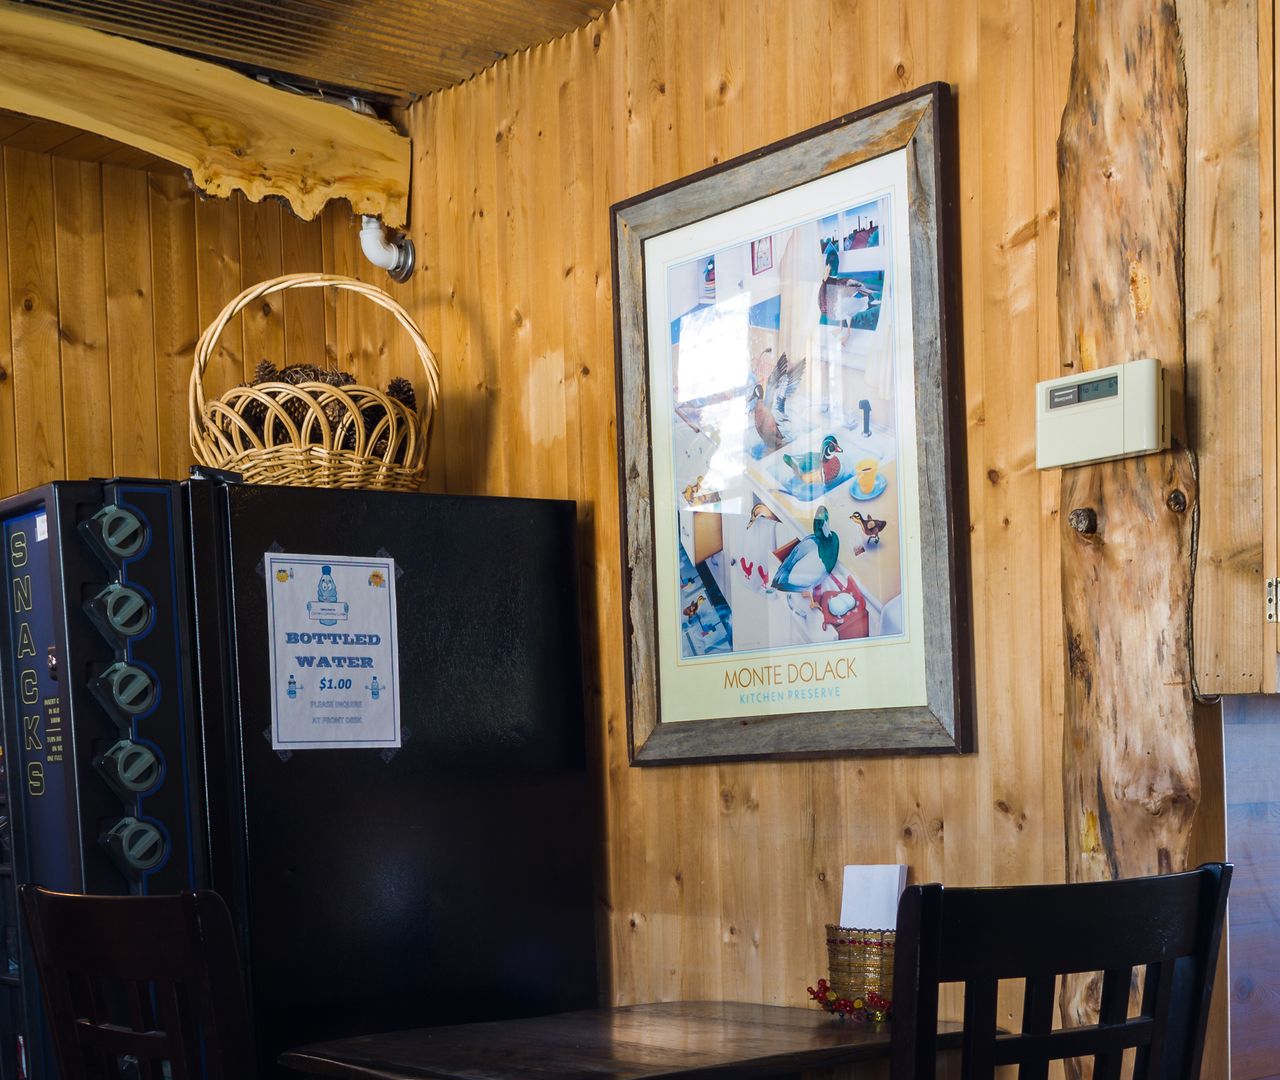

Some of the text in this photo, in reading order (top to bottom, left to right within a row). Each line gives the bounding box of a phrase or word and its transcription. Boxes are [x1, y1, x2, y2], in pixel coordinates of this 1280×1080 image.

[286, 632, 381, 646] BOTTLED
[11, 532, 46, 798] SNACKS
[295, 656, 375, 669] WATER
[724, 657, 857, 690] MONTE DOLACK
[320, 678, 353, 691] $1.00
[739, 686, 841, 705] KITCHEN PRESERVE
[310, 701, 334, 709] PLEASE
